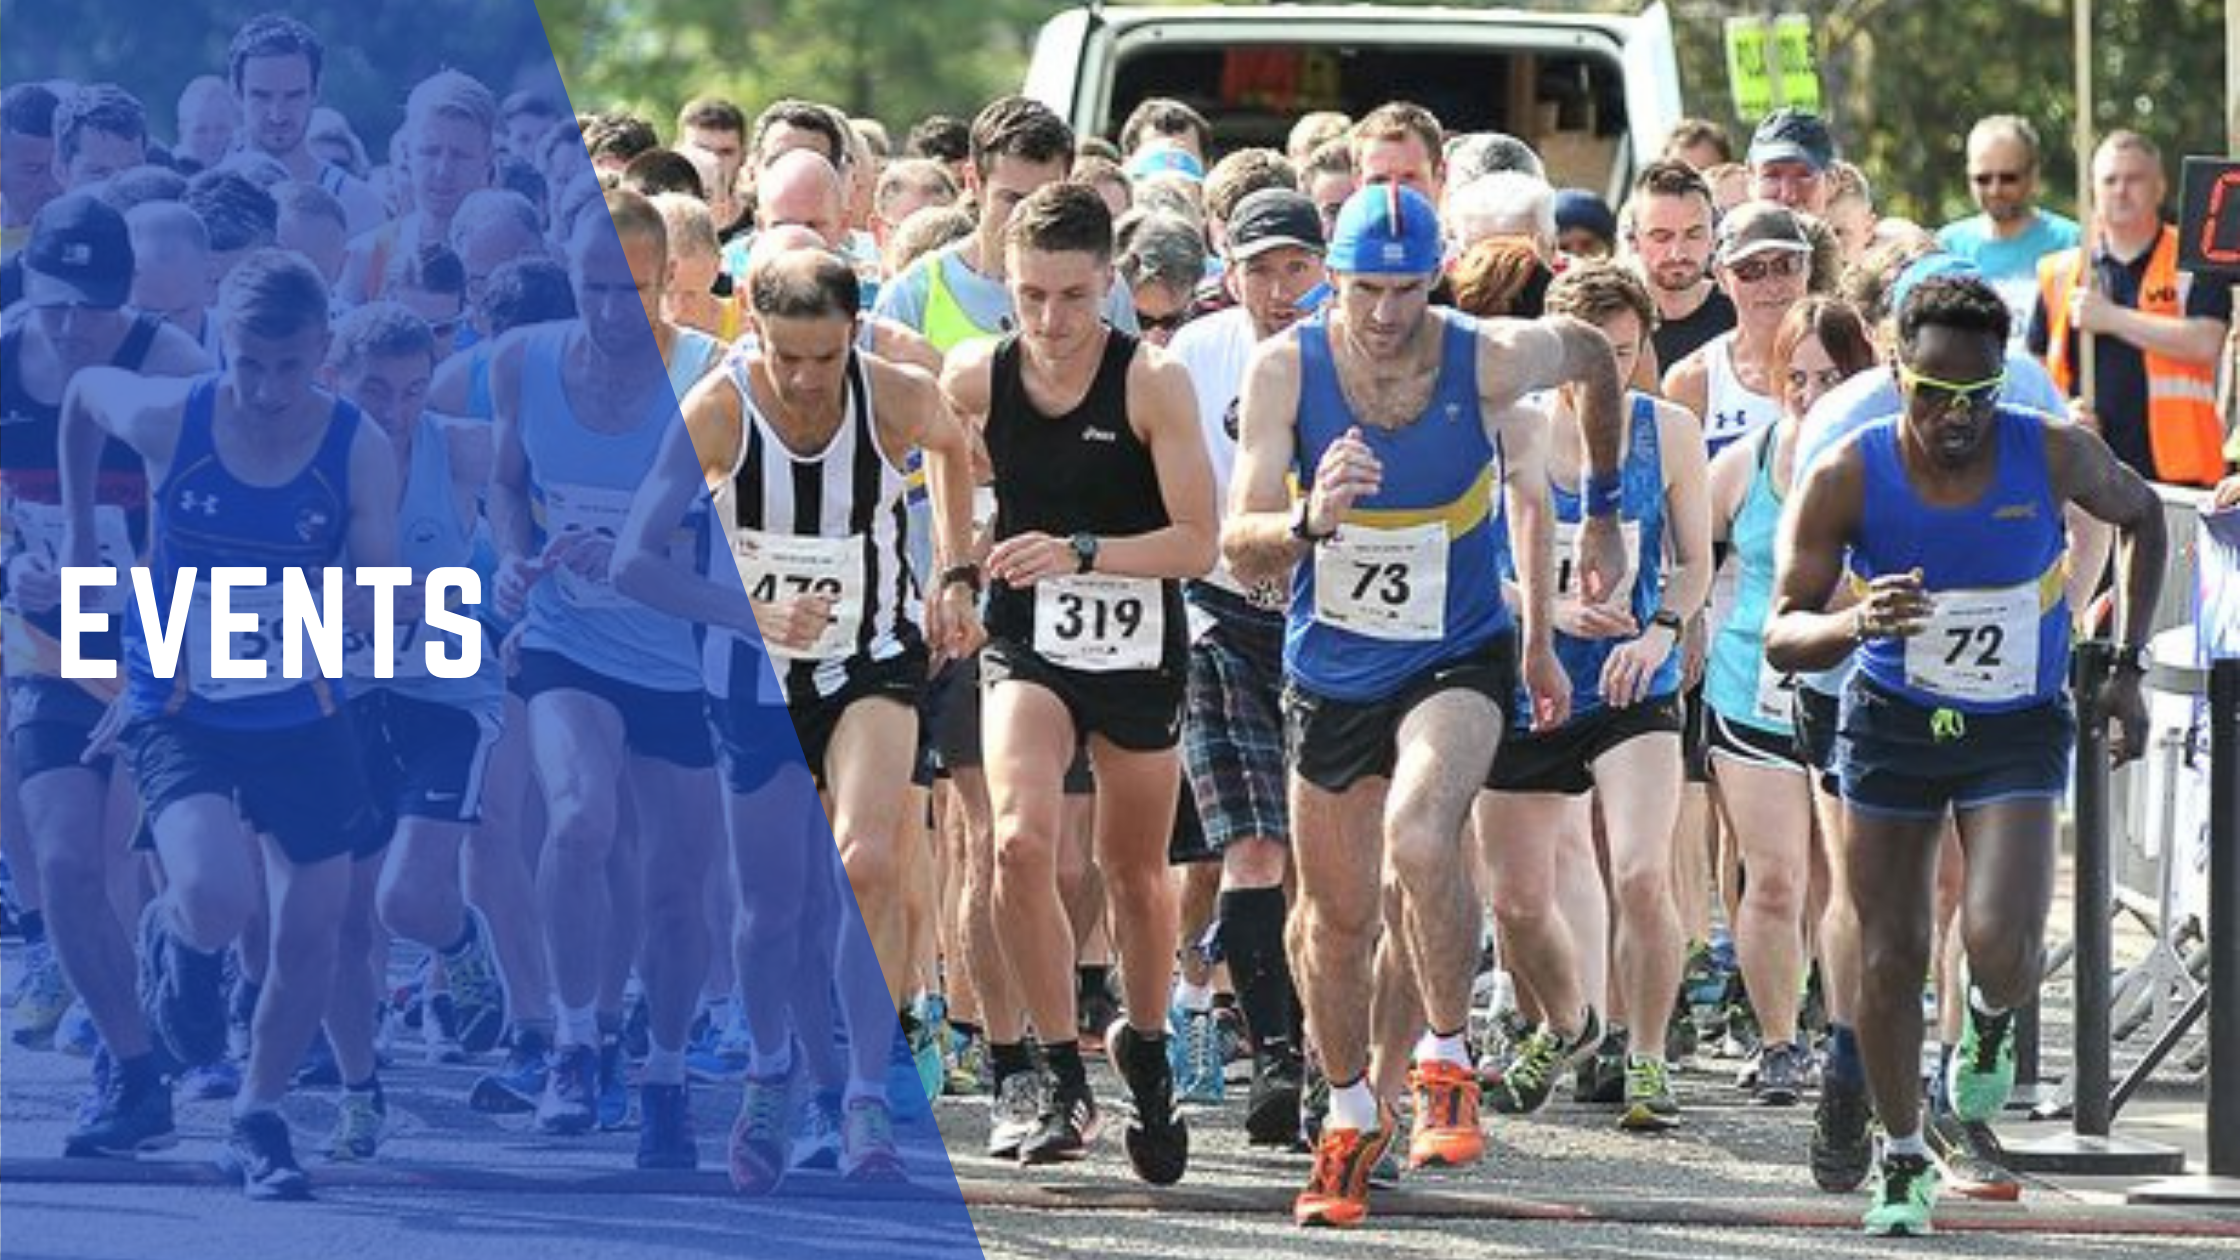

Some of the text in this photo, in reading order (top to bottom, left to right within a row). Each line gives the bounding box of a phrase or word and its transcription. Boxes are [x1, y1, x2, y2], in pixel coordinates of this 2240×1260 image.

[1351, 560, 1410, 605] 73
[1055, 592, 1143, 640] 319
[1944, 624, 2004, 667] 72
